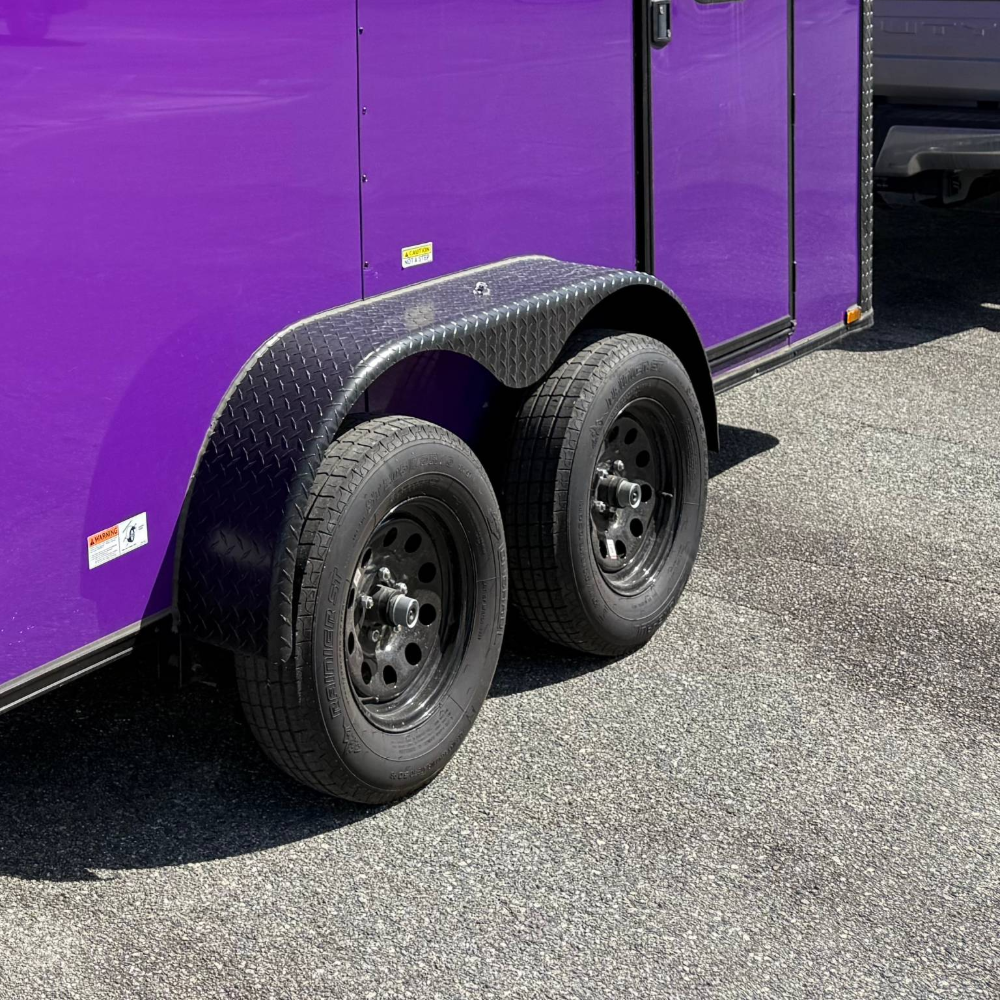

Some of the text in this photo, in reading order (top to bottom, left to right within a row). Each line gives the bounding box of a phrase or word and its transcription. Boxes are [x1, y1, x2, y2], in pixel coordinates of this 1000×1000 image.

[408, 247, 429, 255] CAUTION
[94, 527, 118, 542] WARNING
[323, 566, 343, 720] RAINIER ST
